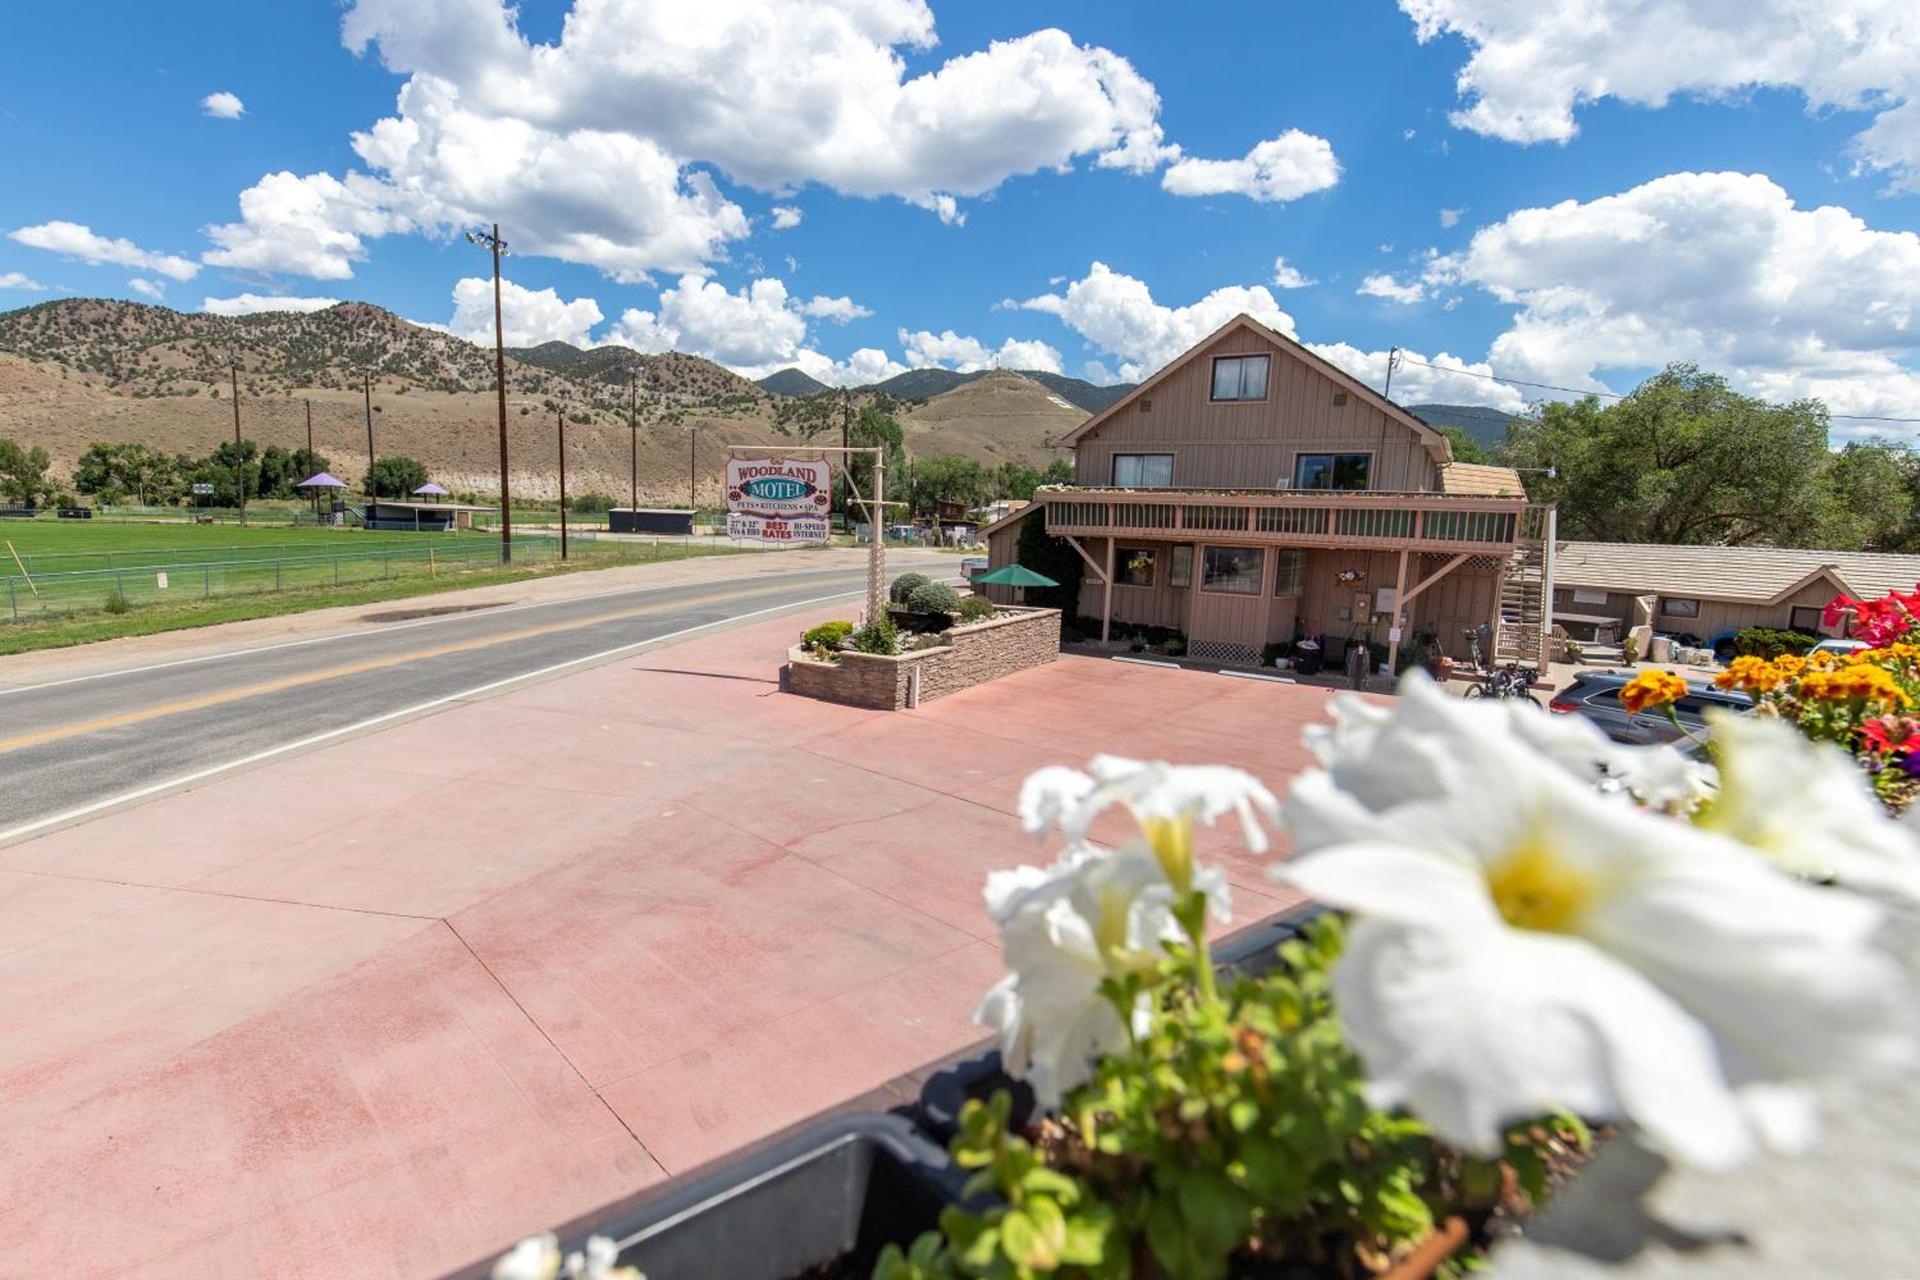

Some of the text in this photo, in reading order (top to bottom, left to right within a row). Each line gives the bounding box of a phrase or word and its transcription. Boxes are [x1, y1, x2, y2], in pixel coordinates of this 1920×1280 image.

[738, 466, 817, 483] WOODLAND
[752, 482, 801, 498] MOTEL
[736, 501, 819, 512] PETS KITCHENS SPA
[765, 521, 789, 530] BEST
[762, 530, 792, 539] RATES
[793, 530, 826, 539] INTERNET
